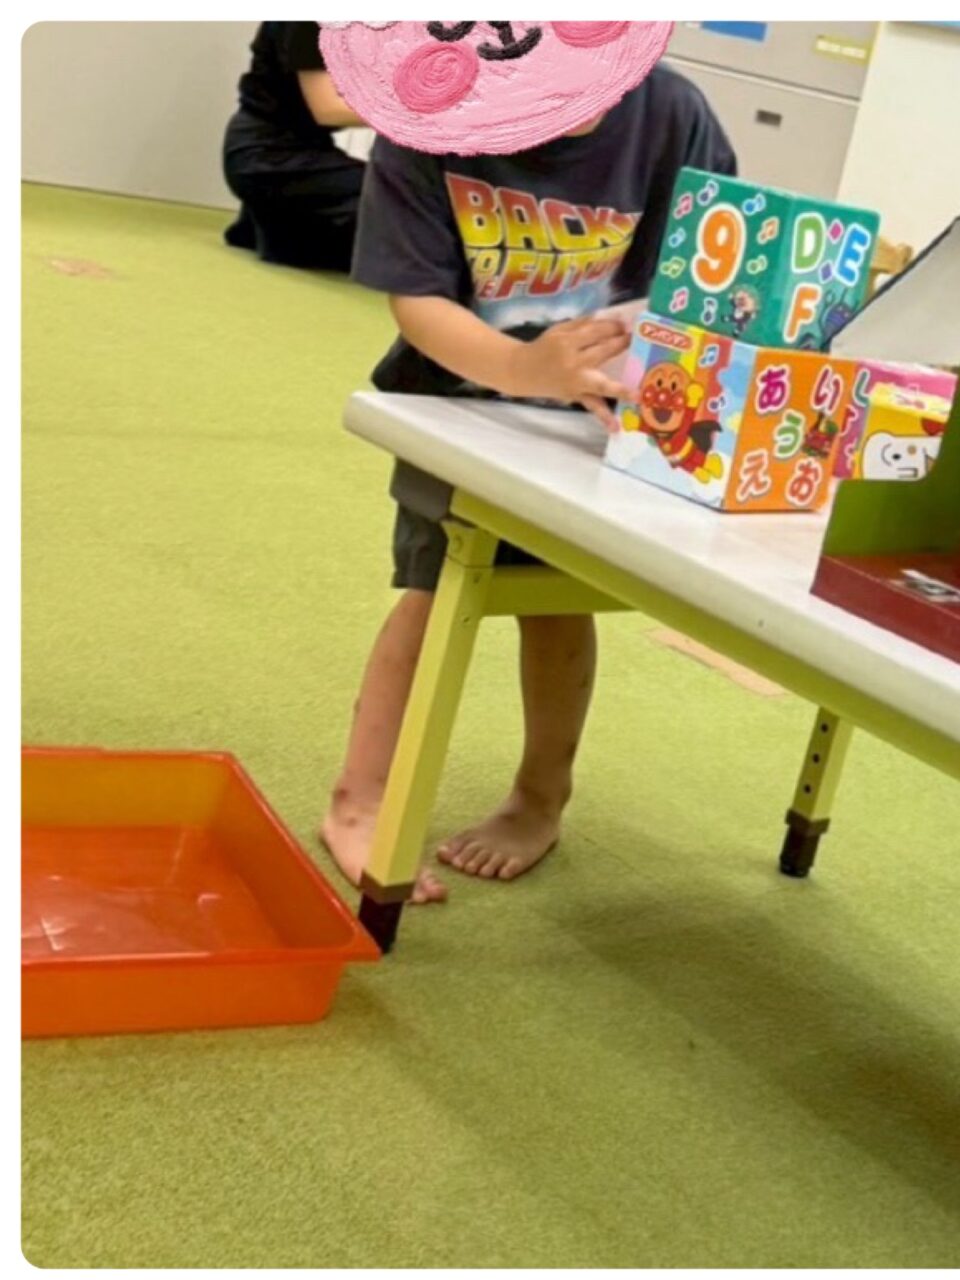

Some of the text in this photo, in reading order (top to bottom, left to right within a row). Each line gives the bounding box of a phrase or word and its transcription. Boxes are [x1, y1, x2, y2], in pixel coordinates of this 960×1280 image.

[444, 171, 622, 251] BACK
[692, 203, 747, 293] 9
[783, 283, 821, 343] F
[756, 365, 790, 414] あ
[811, 366, 843, 415] い
[774, 409, 803, 458] う
[736, 450, 822, 504] え お
